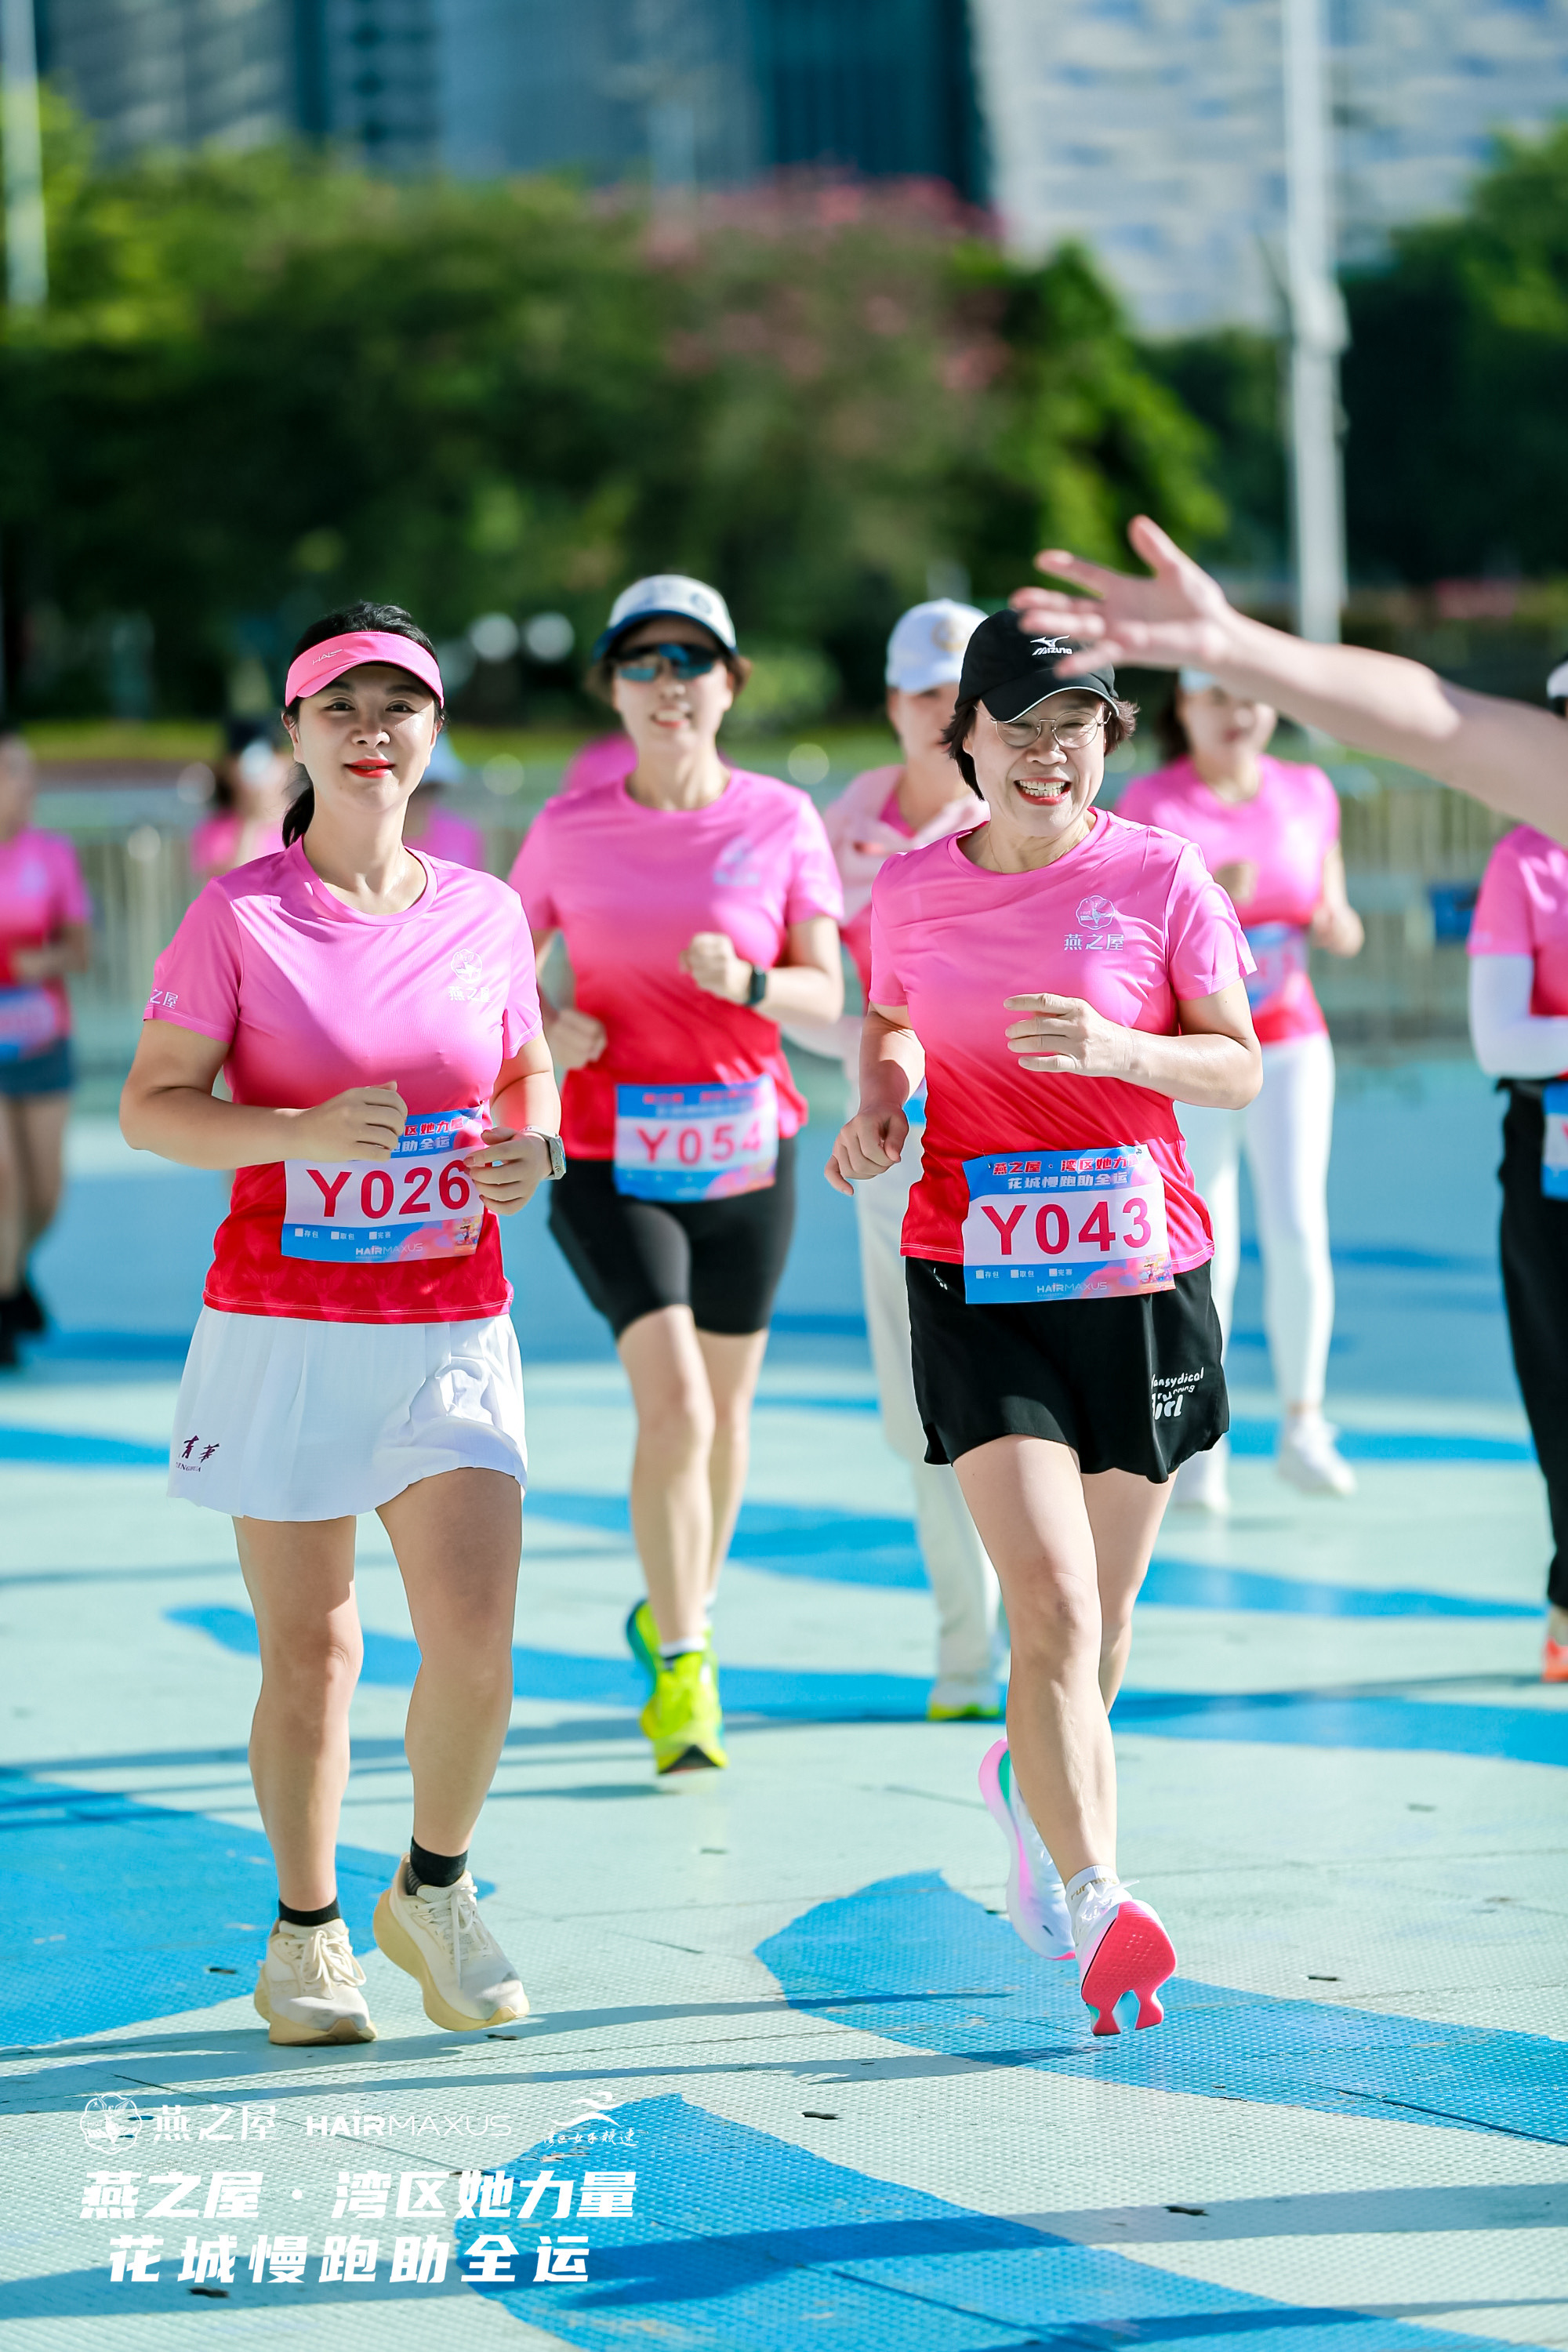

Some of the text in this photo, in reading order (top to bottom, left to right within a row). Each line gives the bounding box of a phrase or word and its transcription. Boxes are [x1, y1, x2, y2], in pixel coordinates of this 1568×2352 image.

[1064, 933, 1124, 952] 燕之屋
[148, 988, 179, 1010] 之屋
[635, 1119, 762, 1166] Y054
[306, 1159, 470, 1220] Y026
[1007, 1171, 1128, 1190] 花城慢跑助全运
[303, 1230, 319, 1239] 存包
[981, 1196, 1152, 1256] Y043
[355, 1243, 423, 1256] HAIRMAXUS
[1036, 1281, 1108, 1294] HAIRMAXUS
